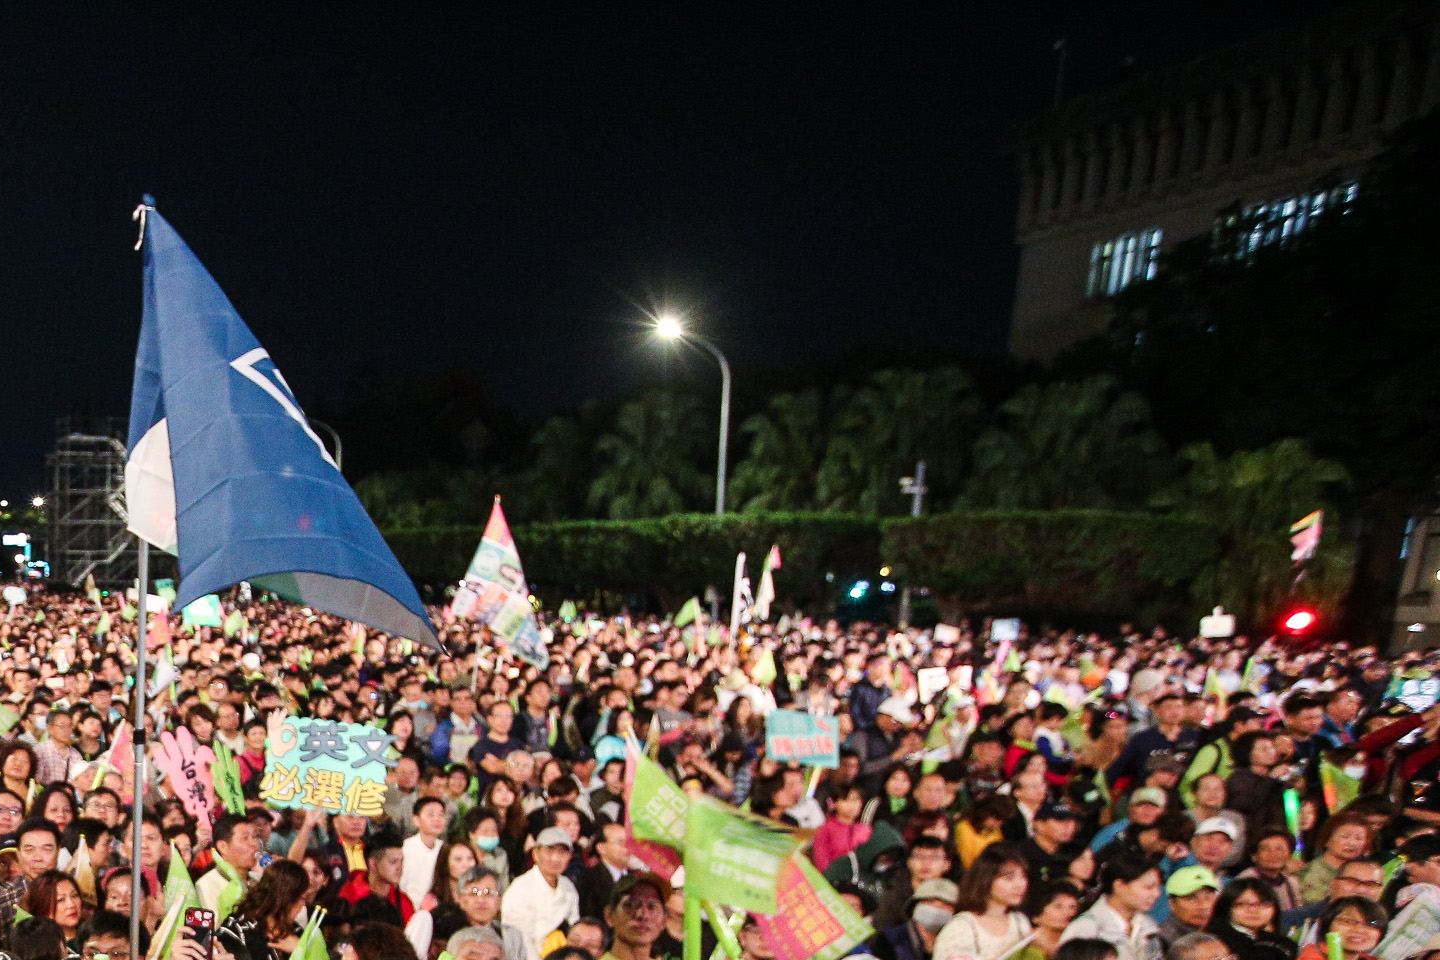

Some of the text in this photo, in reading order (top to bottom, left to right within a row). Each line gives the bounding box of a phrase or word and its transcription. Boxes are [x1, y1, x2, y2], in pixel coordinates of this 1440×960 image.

[300, 721, 399, 768] 英文
[181, 759, 207, 810] 台灣
[258, 762, 389, 816] 必選修
